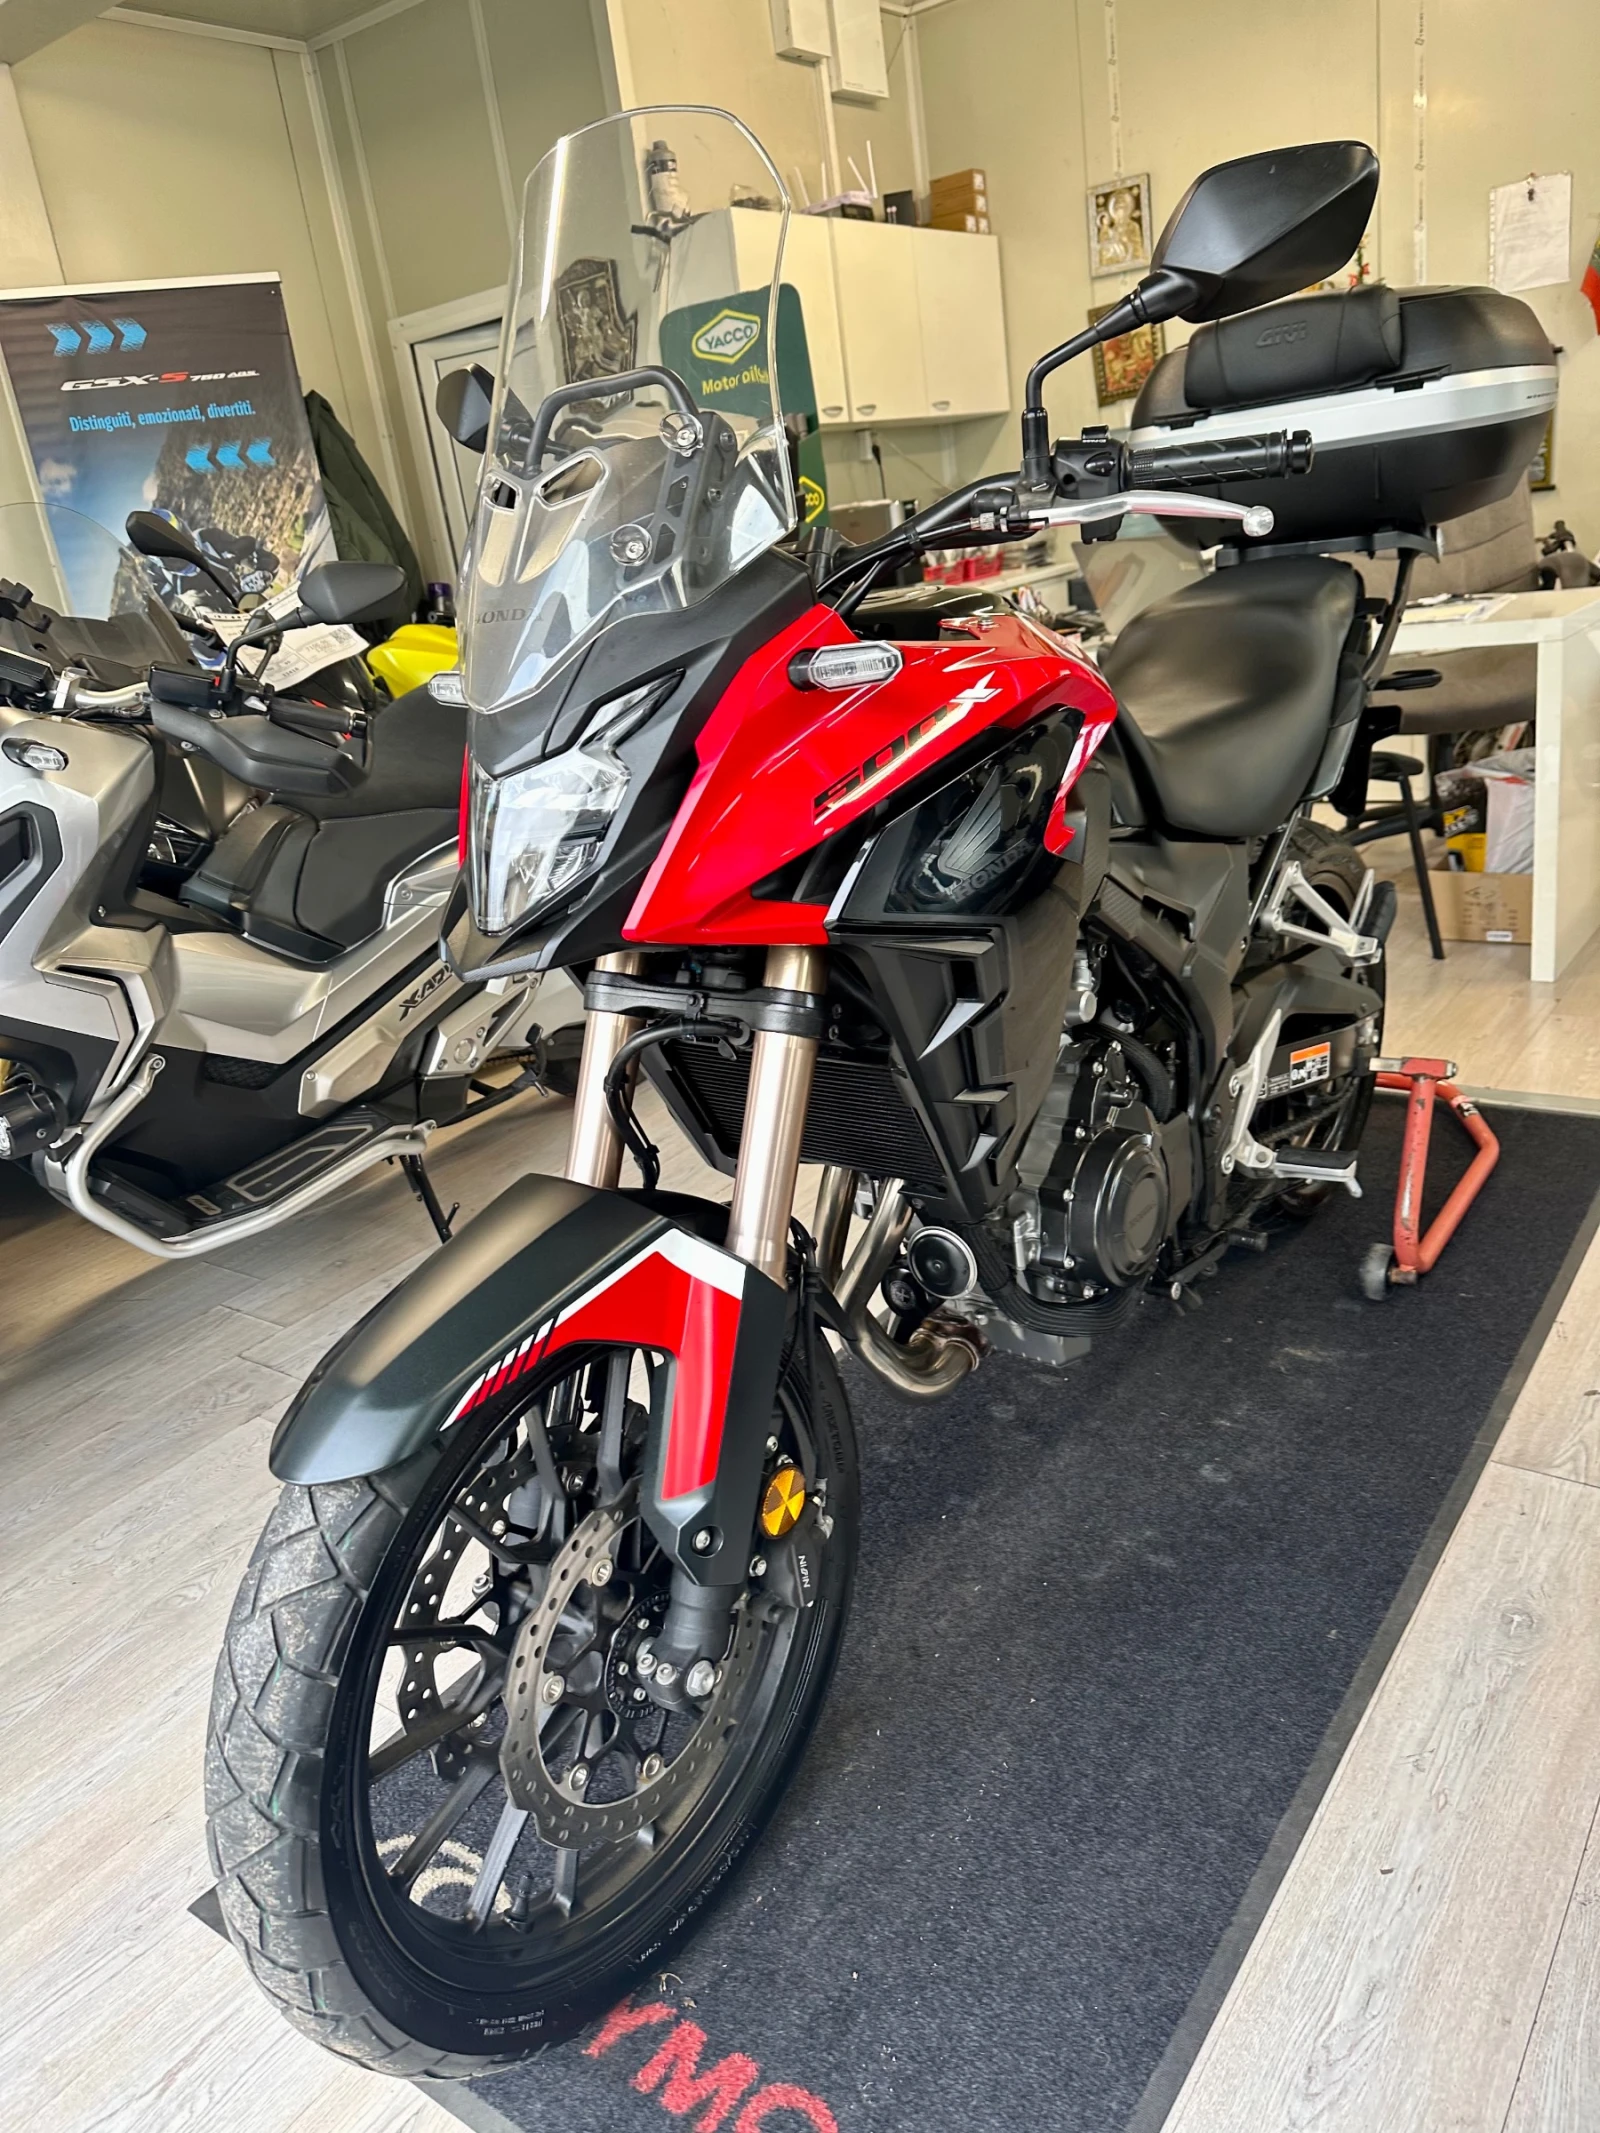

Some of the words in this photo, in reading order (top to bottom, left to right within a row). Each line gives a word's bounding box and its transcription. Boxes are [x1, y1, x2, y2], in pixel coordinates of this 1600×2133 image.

[704, 325, 754, 350] YACCO
[1256, 321, 1307, 348] GIVI
[60, 371, 189, 391] GSX-S
[702, 372, 740, 395] Motor
[69, 411, 136, 432] Distinguiti,
[138, 405, 206, 426] emozionati,
[207, 400, 257, 419] divertiti.
[476, 607, 544, 624] OND
[952, 838, 1035, 903] HONDA
